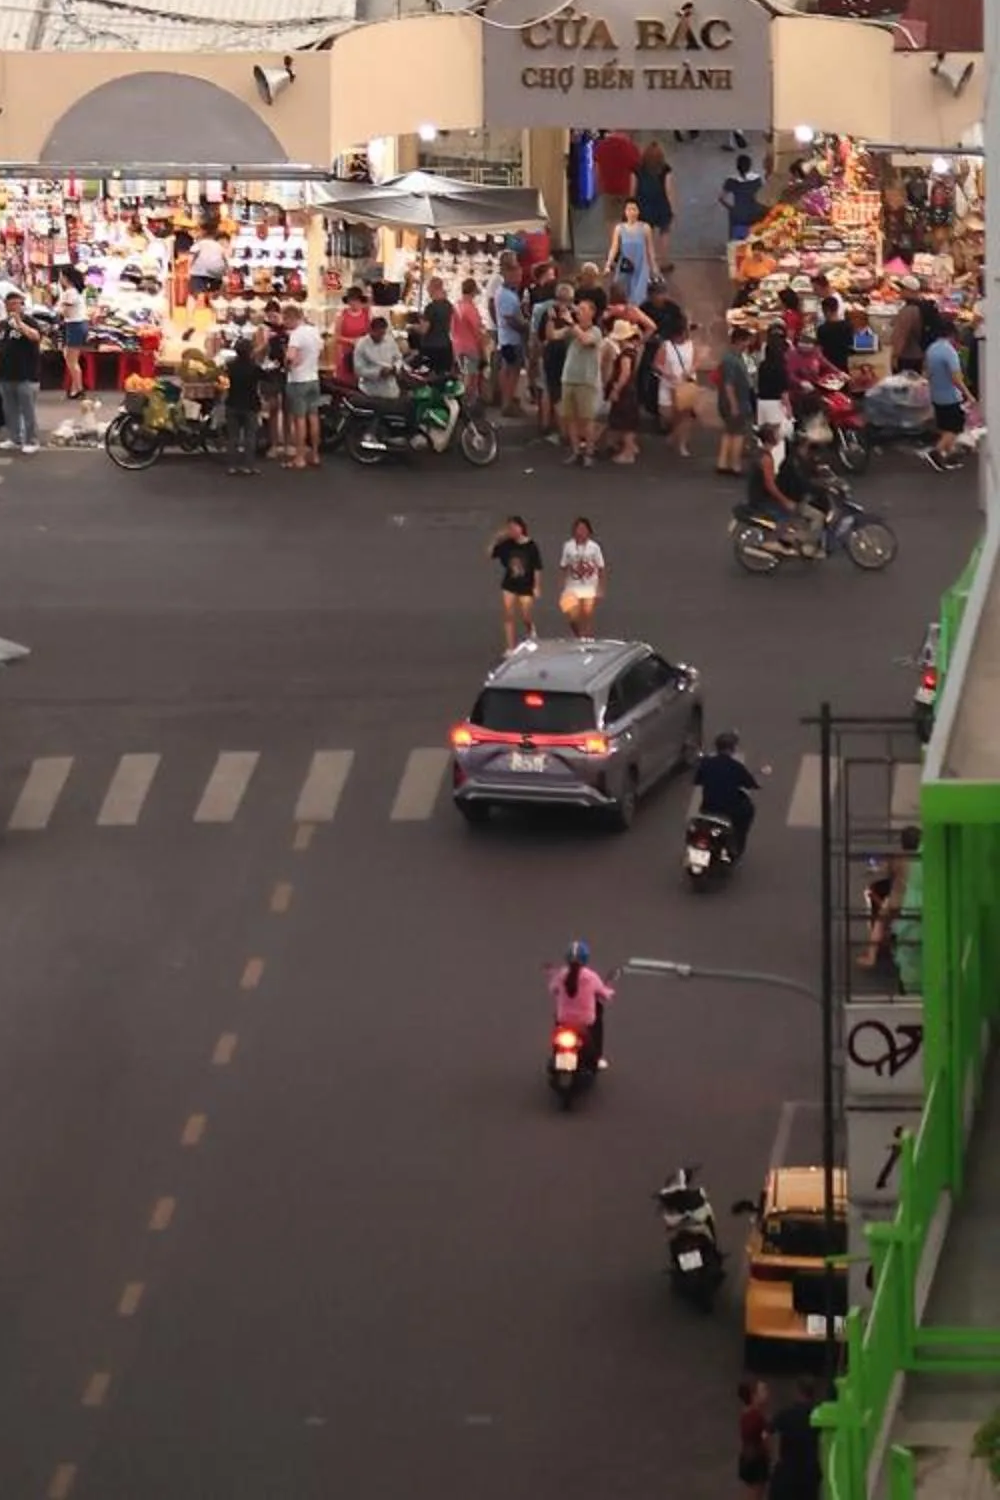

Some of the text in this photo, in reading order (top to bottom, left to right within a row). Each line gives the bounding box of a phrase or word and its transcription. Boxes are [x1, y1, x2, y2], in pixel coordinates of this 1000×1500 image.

[521, 2, 733, 50] CỬA BẮC
[521, 58, 733, 93] CHỢ BẾN THÀNH
